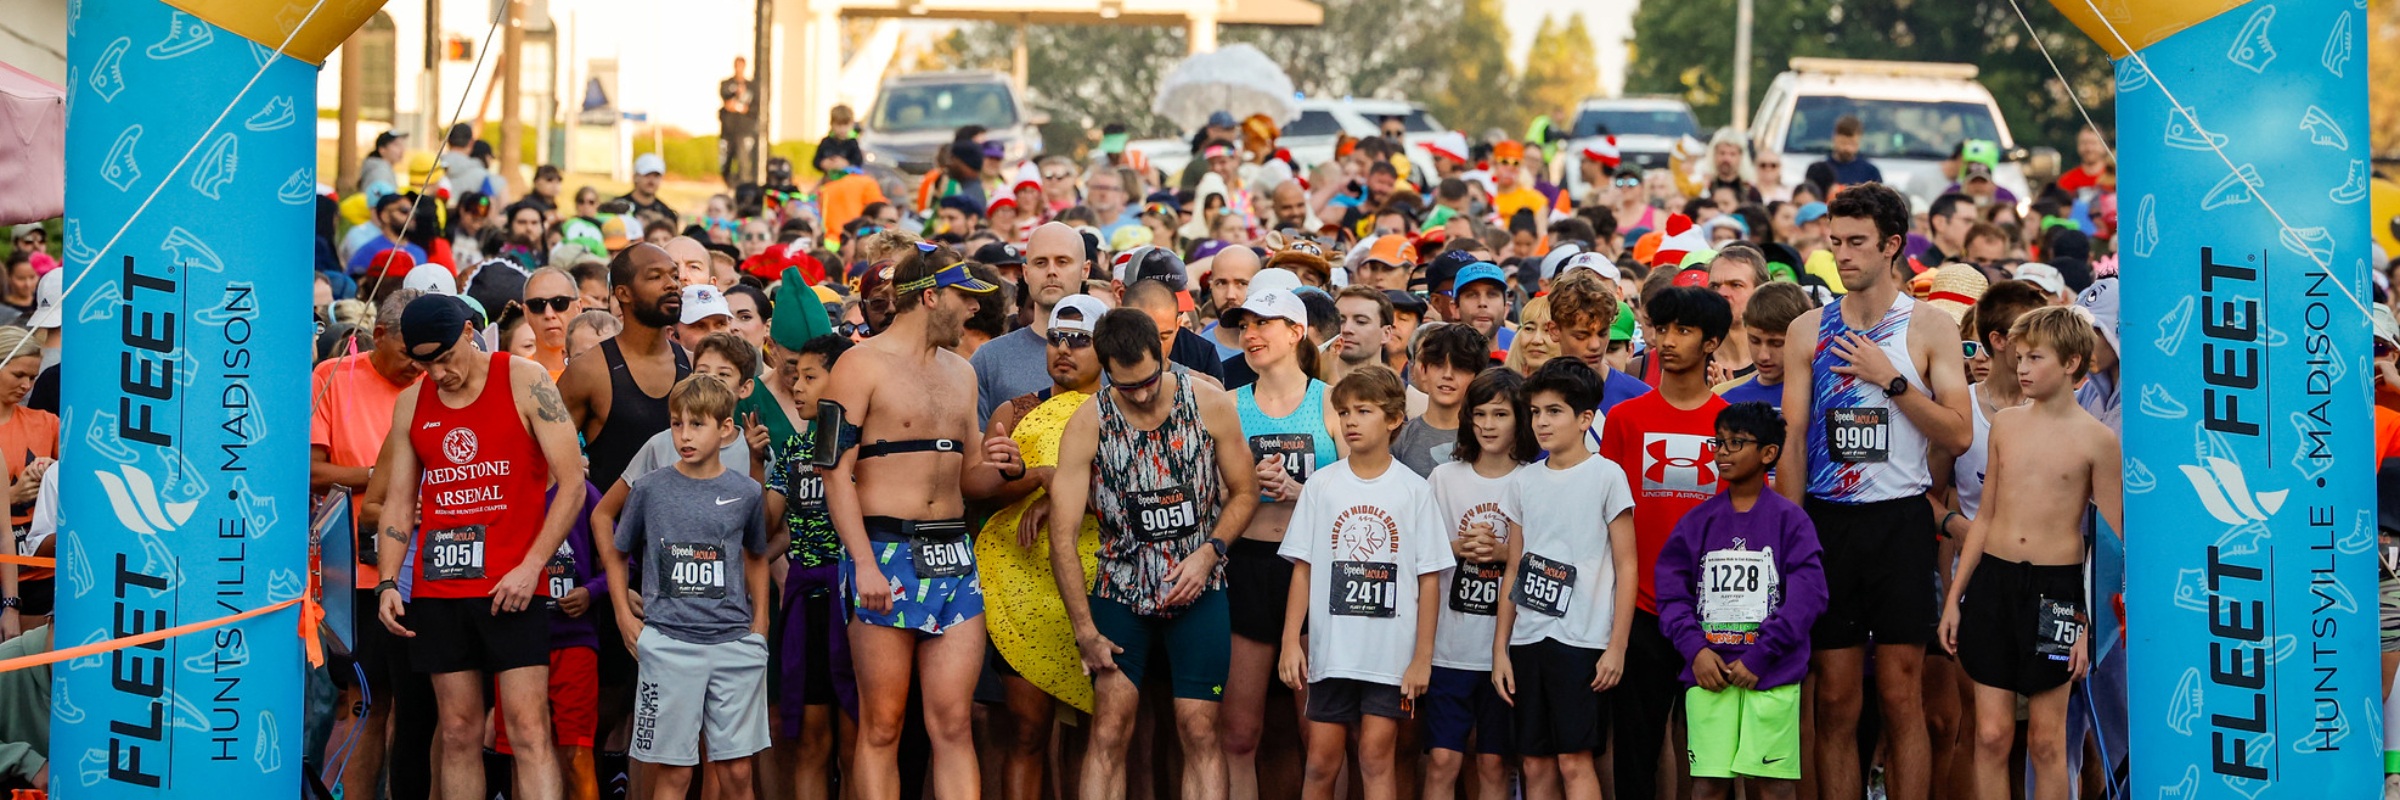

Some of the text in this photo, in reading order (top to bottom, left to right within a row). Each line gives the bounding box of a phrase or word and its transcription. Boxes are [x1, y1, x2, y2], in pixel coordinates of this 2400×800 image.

[1835, 427, 1875, 449] 990
[427, 460, 511, 485] REDSTONE
[435, 485, 503, 507] ARSENAL
[799, 476, 824, 499] 817
[108, 255, 176, 788] FLEET FEET
[211, 287, 252, 760] HUNTSVILLE MADISON
[1141, 505, 1184, 531] 905
[2201, 246, 2269, 780] FLEET FEET
[2304, 272, 2340, 752] HUNTSVILLE MADISON
[1350, 504, 1386, 519] MIDDLE
[1383, 515, 1399, 554] SCHOOL
[433, 544, 471, 568] 305
[922, 543, 958, 567] 550
[671, 562, 712, 585] 406
[1711, 564, 1759, 592] 1228
[1345, 580, 1381, 604] 241
[1459, 577, 1497, 603] 326
[1524, 571, 1559, 603] 555
[643, 696, 659, 750] UNDER
